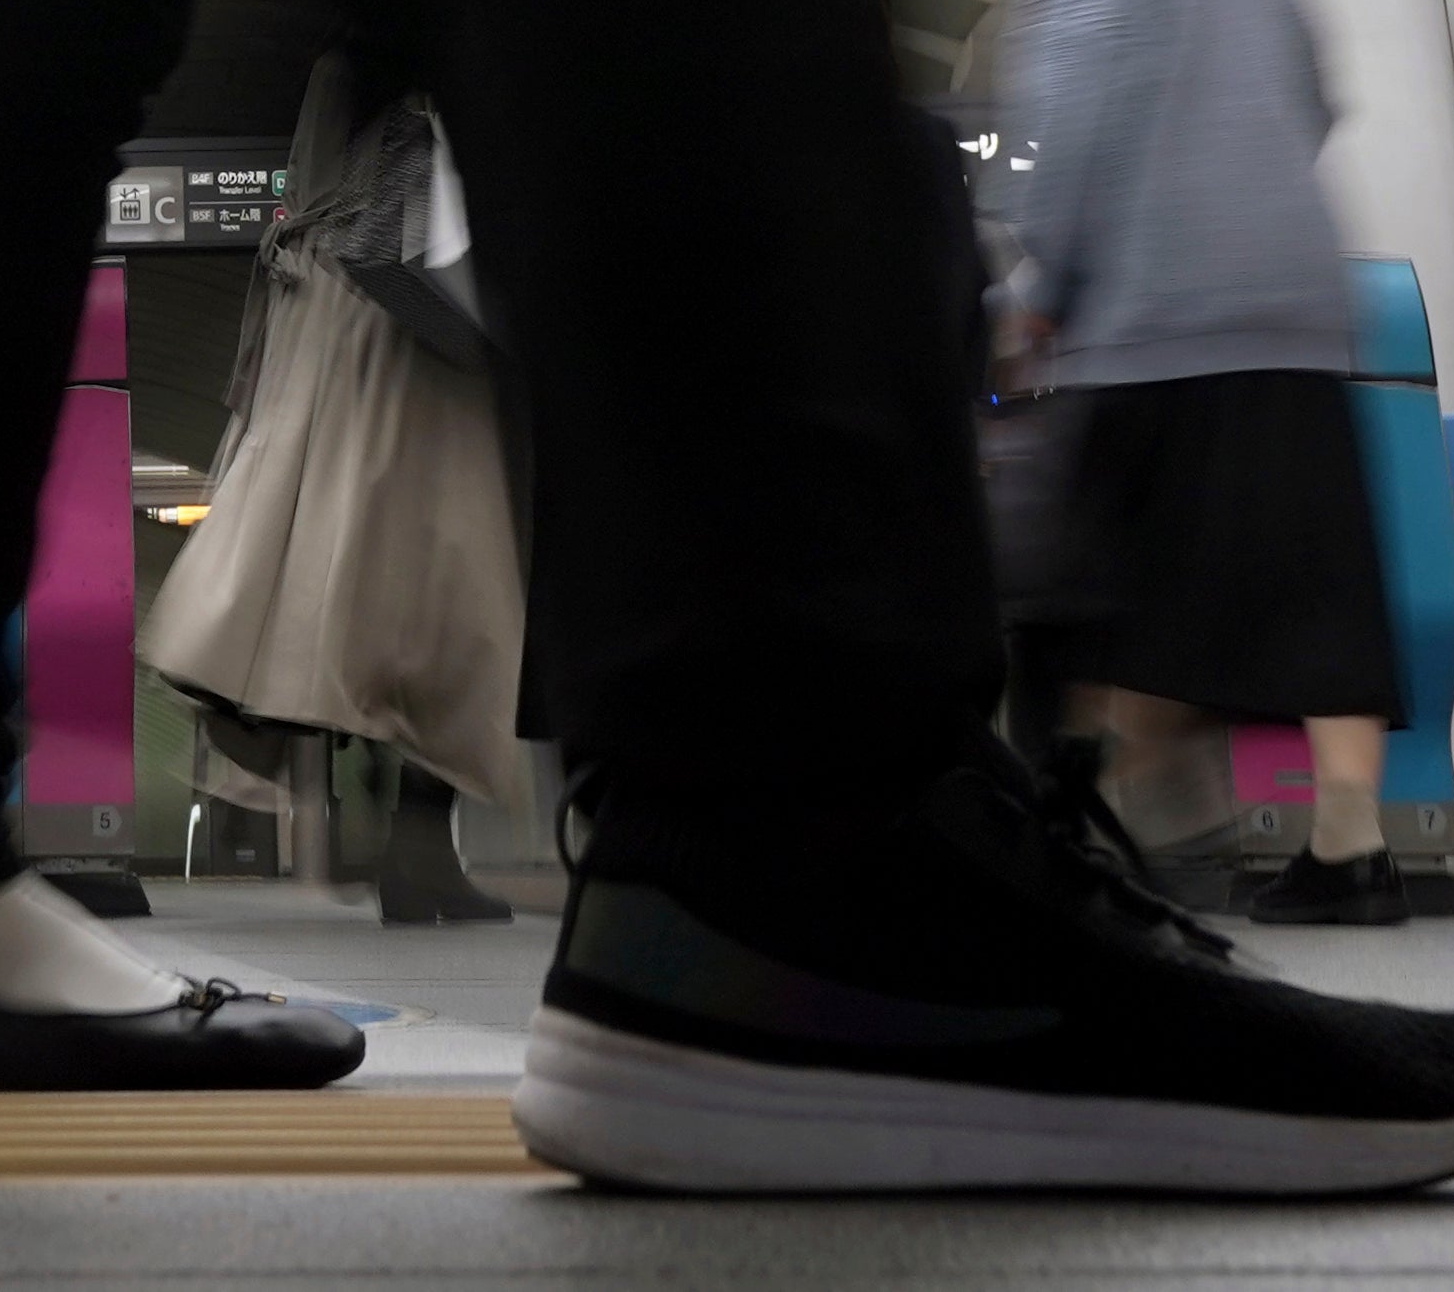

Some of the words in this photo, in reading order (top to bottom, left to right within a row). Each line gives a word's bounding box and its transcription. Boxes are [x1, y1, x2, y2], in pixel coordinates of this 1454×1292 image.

[217, 170, 268, 185] のりかえ階
[155, 197, 176, 224] C
[219, 208, 261, 222] ホーム階
